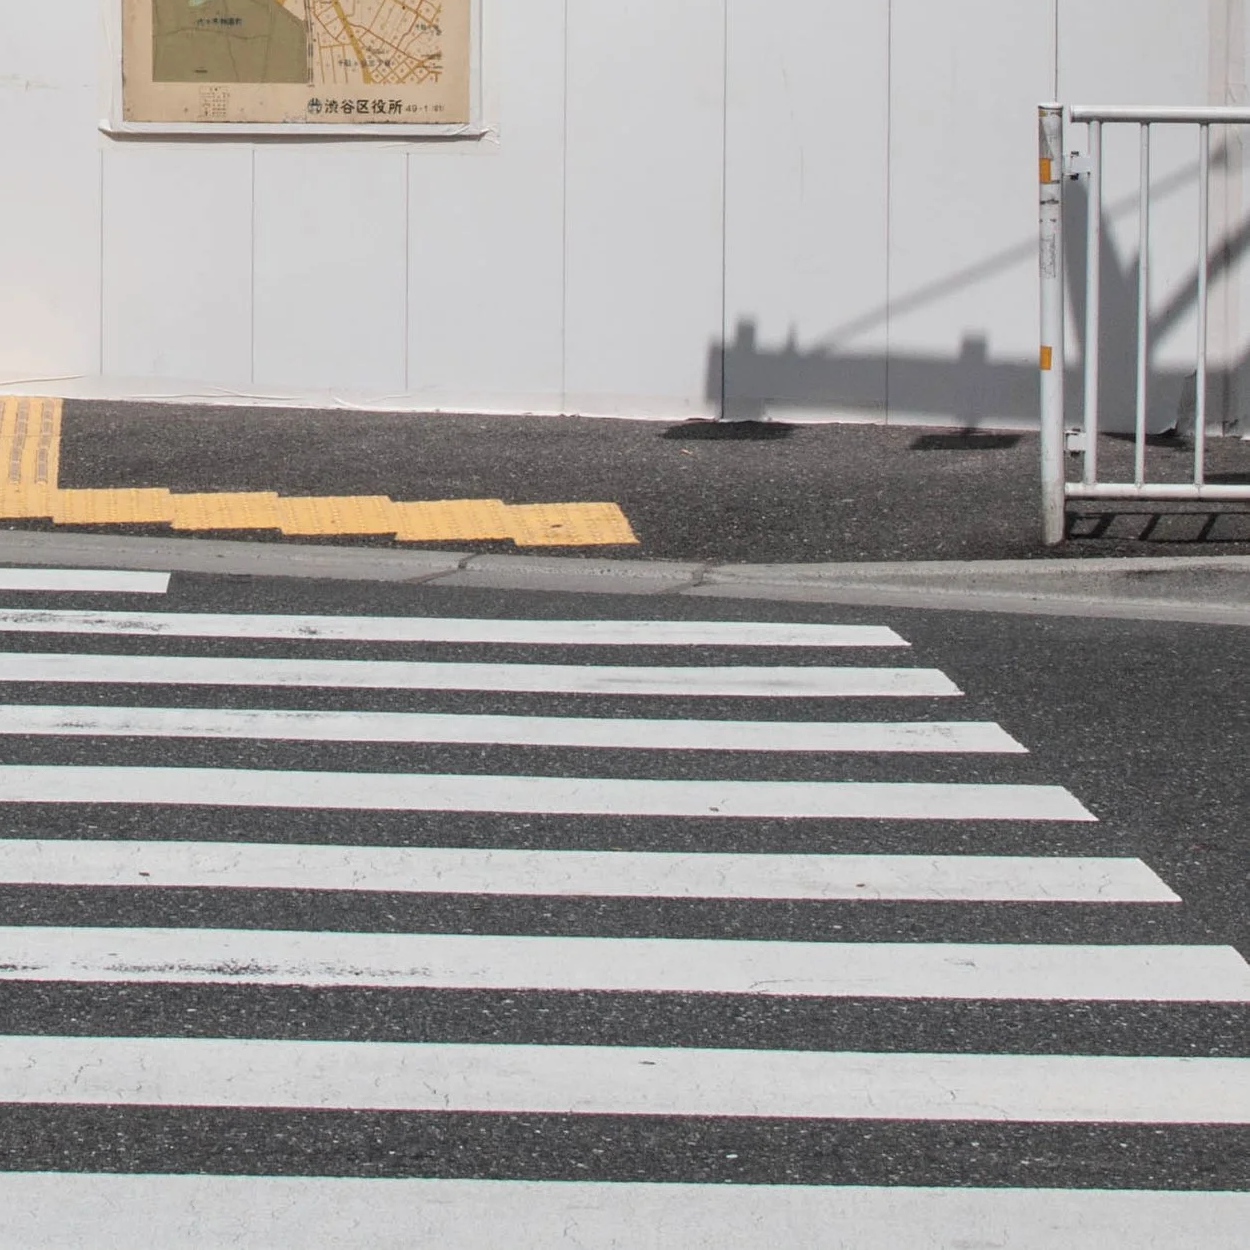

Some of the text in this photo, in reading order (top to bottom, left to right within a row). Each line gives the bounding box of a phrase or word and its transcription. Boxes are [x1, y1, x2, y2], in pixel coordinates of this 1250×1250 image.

[324, 99, 404, 115] 渋谷区役所
